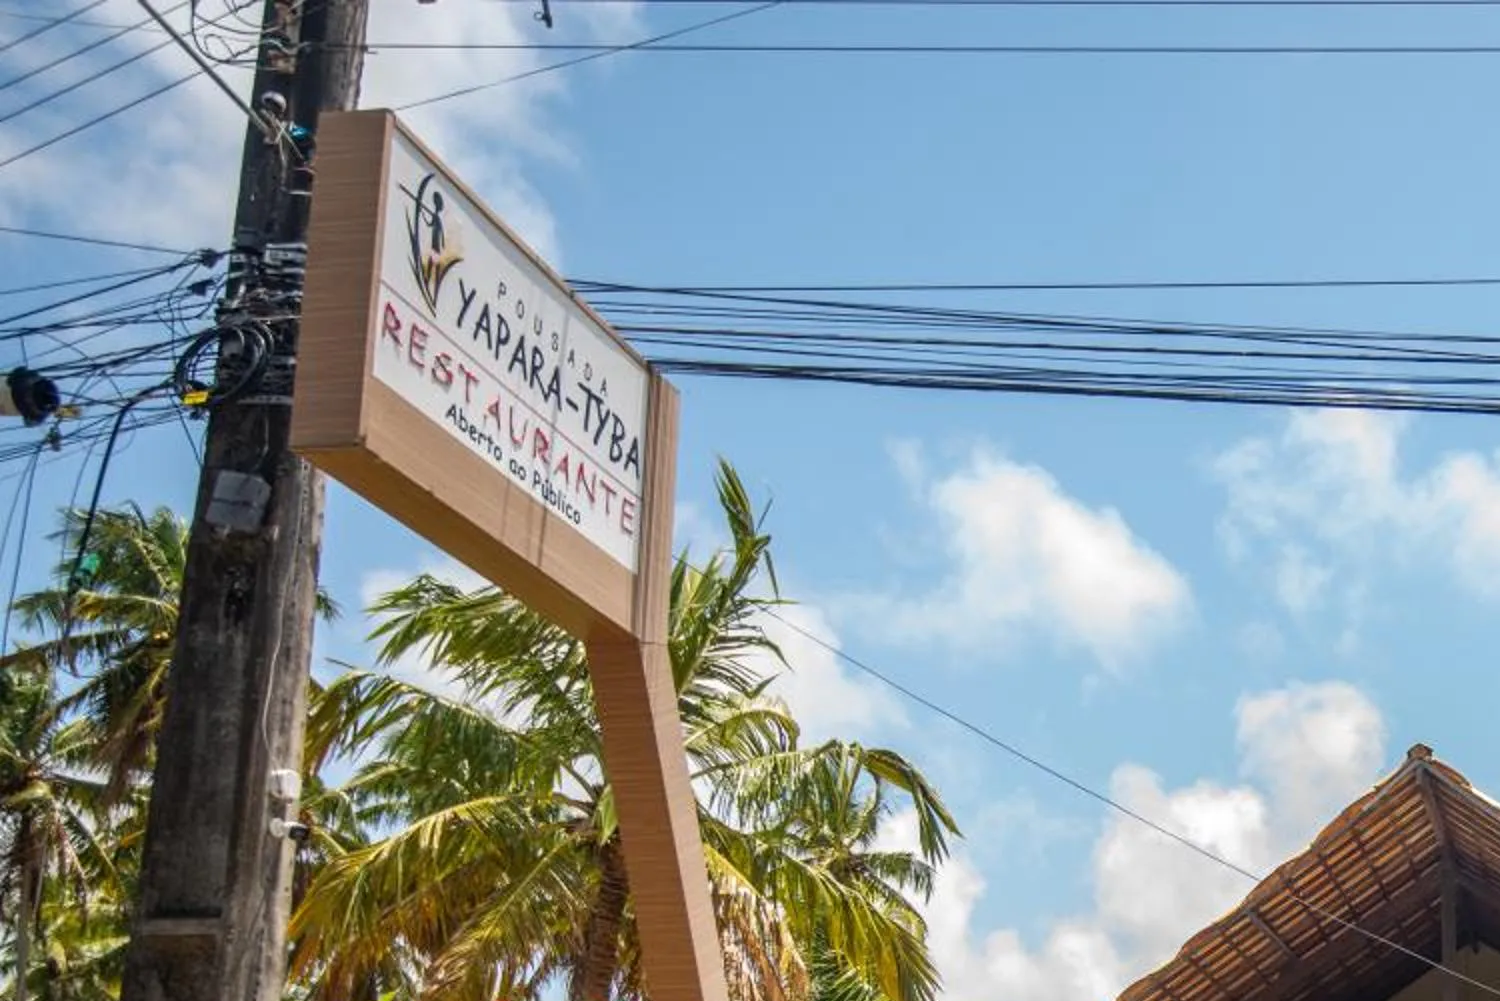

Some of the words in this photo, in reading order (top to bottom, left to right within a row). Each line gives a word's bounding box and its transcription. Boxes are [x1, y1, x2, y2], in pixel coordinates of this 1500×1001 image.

[381, 302, 636, 535] RESTAURANTE
[458, 279, 641, 481] YAPARA-TYBA
[498, 282, 608, 397] POUSADA
[445, 404, 503, 461] Aberto
[509, 459, 527, 481] ao
[532, 471, 581, 524] Público
